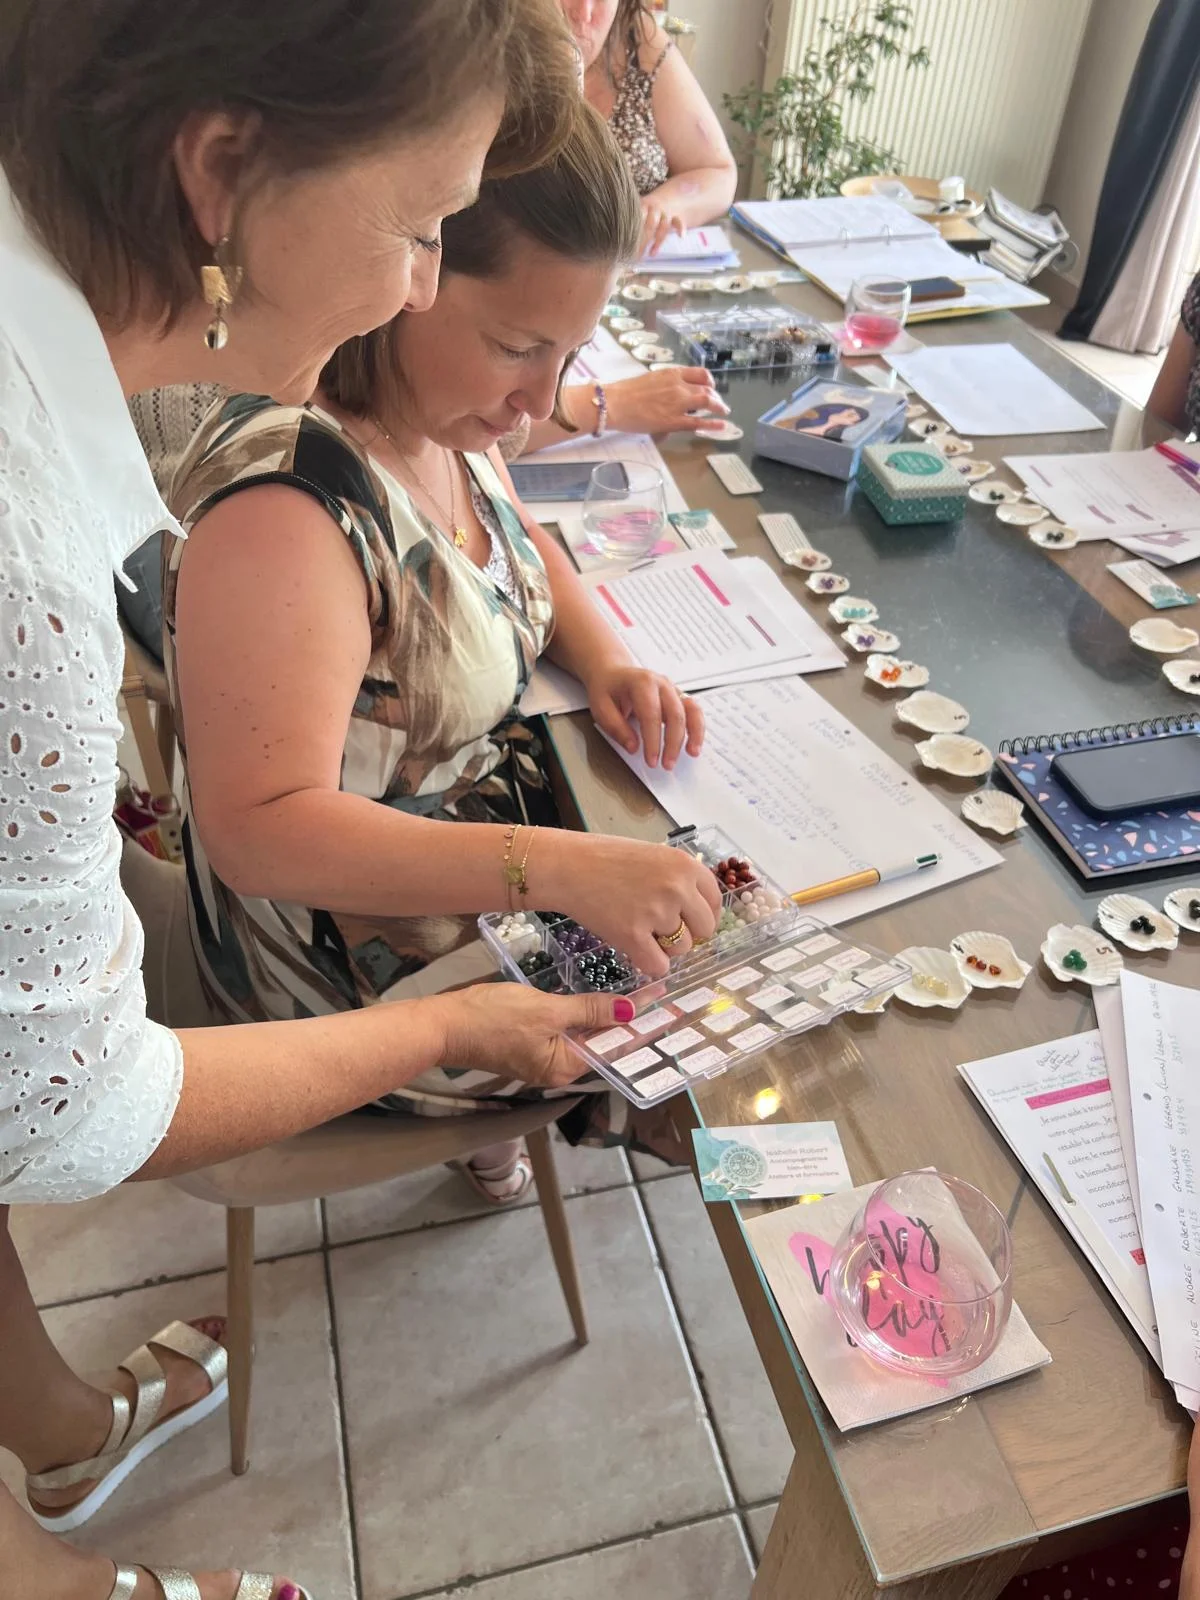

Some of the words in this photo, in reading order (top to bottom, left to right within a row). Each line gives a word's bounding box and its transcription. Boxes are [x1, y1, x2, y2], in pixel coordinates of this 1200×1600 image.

[1049, 1114, 1067, 1122] vous
[1068, 1107, 1082, 1117] aide
[1097, 1199, 1115, 1208] vous
